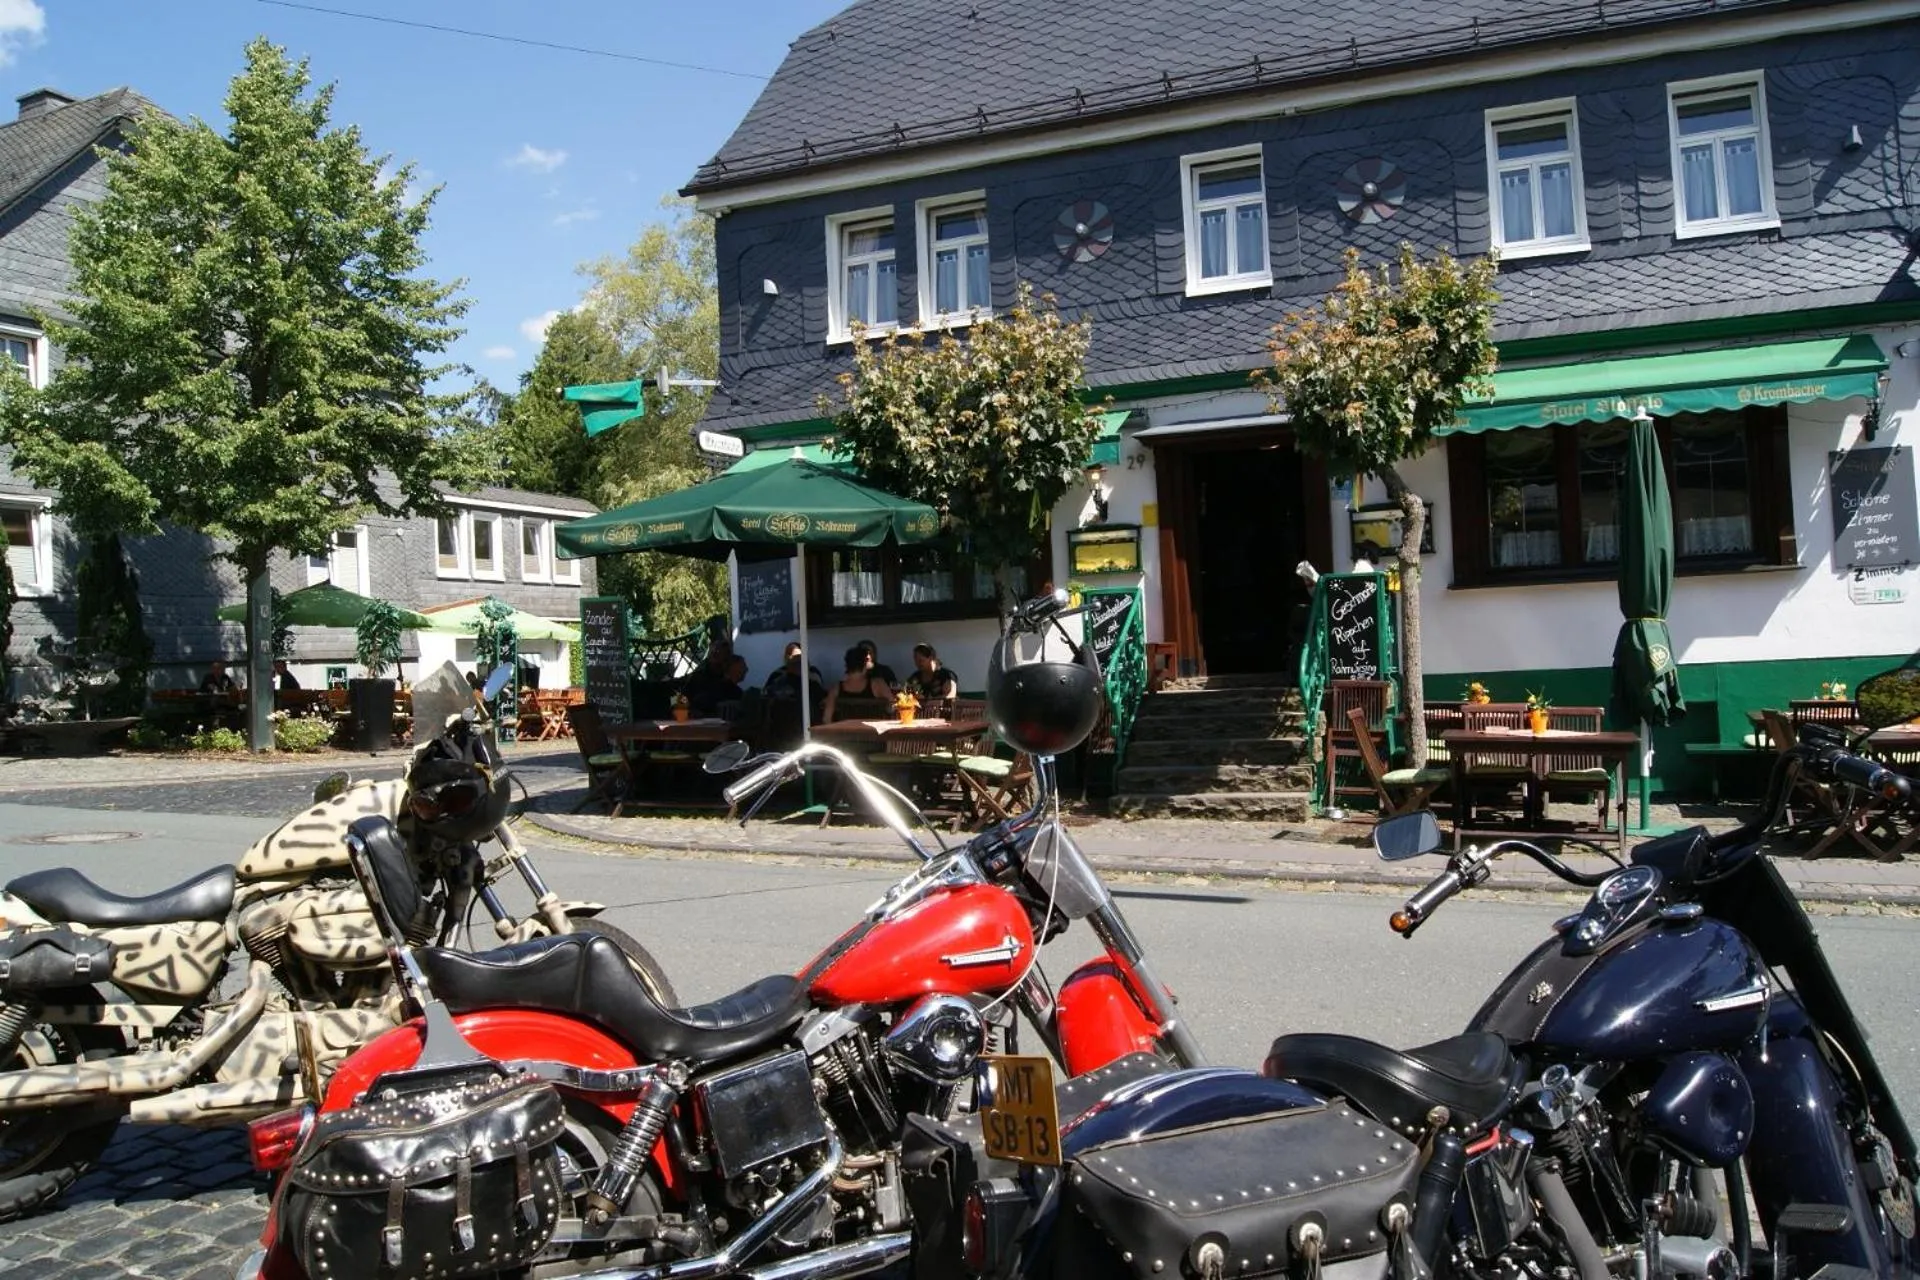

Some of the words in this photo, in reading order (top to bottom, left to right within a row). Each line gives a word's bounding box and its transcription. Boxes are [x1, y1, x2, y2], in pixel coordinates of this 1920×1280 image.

[1754, 382, 1826, 401] Krombacher
[1541, 401, 1588, 421] Hotel
[1126, 454, 1146, 470] 29
[1841, 489, 1890, 510] Schöne
[1847, 511, 1894, 529] Zimmer
[584, 609, 616, 626] Zander
[1331, 616, 1374, 646] Rippchen
[1352, 640, 1371, 661] auf
[1003, 1065, 1035, 1105] MT
